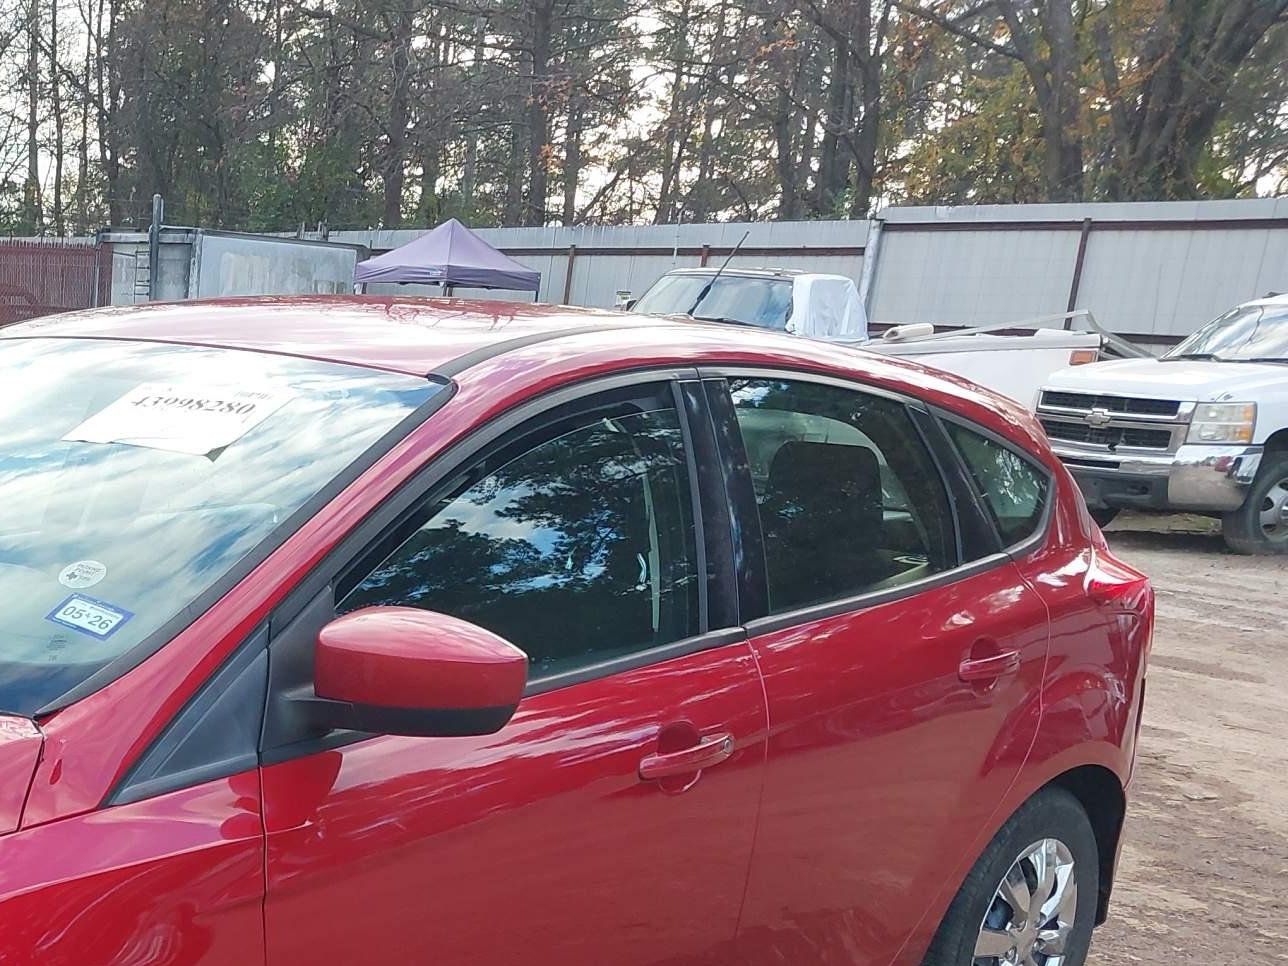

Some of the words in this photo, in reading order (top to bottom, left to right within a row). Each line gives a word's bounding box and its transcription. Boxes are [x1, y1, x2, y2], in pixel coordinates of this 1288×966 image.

[130, 394, 257, 416] 43998280
[62, 605, 86, 620] 05
[88, 614, 113, 630] 26
